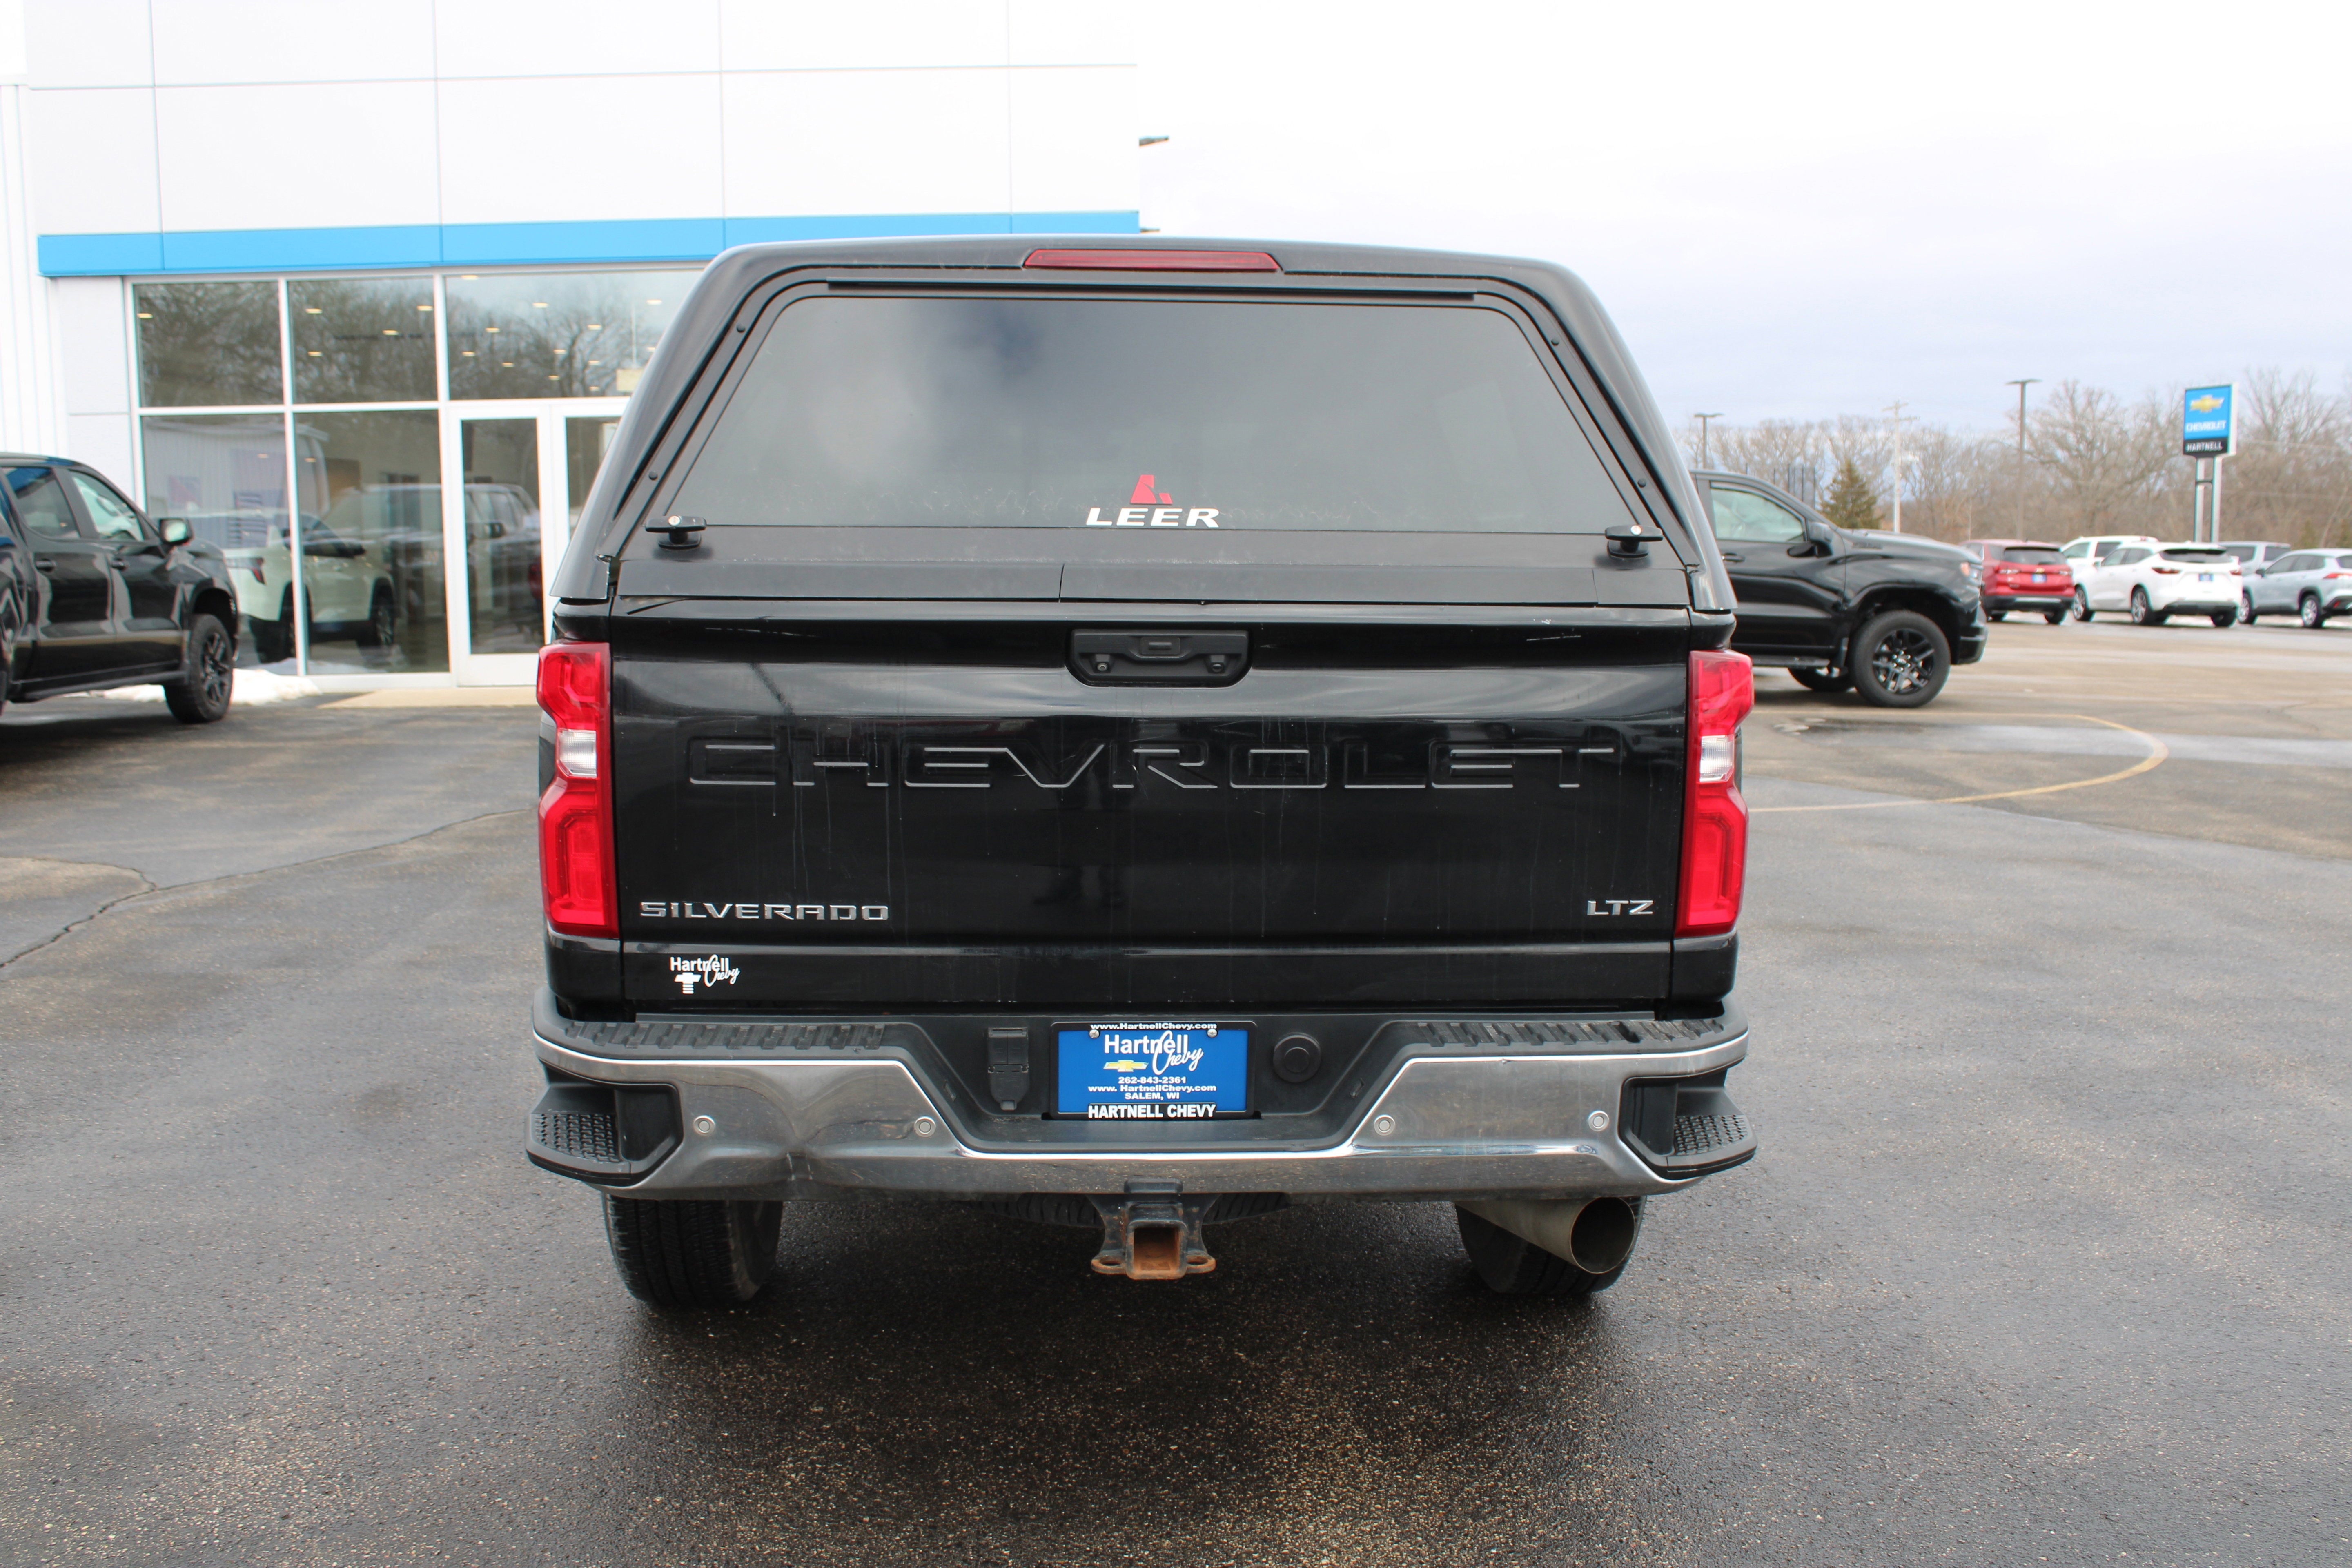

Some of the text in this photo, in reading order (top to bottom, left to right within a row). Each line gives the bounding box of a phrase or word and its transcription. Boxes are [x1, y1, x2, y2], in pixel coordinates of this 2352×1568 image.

[2186, 420, 2227, 432] CHEVROLET
[2187, 441, 2223, 452] HARTNELL
[1086, 508, 1219, 528] LEER
[689, 736, 1615, 789] CHEVROLET
[640, 902, 889, 921] SILVERADO
[1587, 900, 1653, 915] LTZ
[670, 956, 730, 971] Hartnell
[704, 954, 740, 987] Chevy
[1104, 1034, 1188, 1054] Hartnell
[1152, 1030, 1204, 1075] Chevy
[1120, 1085, 1217, 1093] HartnellChevy.com
[1124, 1092, 1164, 1100] SALEM,
[1088, 1103, 1216, 1118] HARTNELL CHEVY
